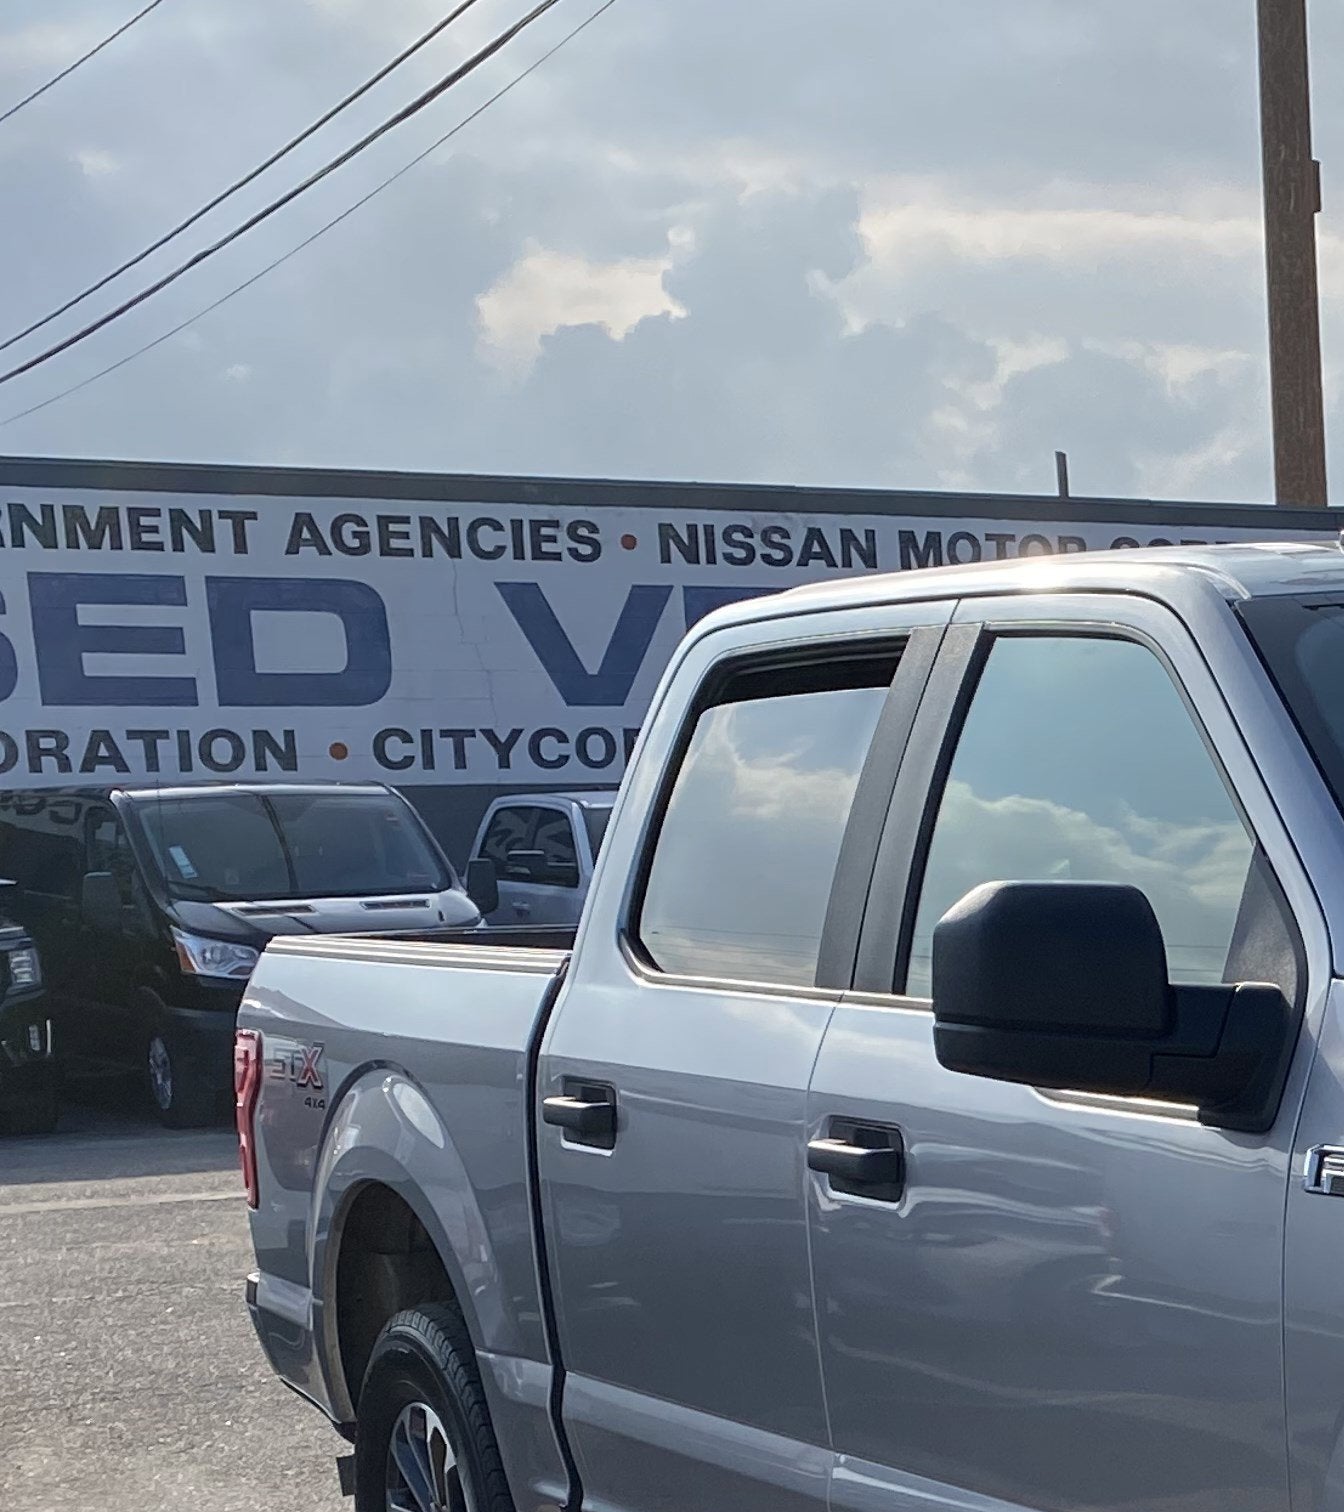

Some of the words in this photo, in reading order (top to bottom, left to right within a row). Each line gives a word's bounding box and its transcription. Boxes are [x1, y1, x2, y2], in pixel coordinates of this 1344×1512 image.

[0, 503, 258, 554] NMENT
[285, 512, 602, 563] AGENCIES
[658, 523, 878, 568] NISSAN
[0, 571, 392, 707] ED
[269, 1041, 325, 1089] STX
